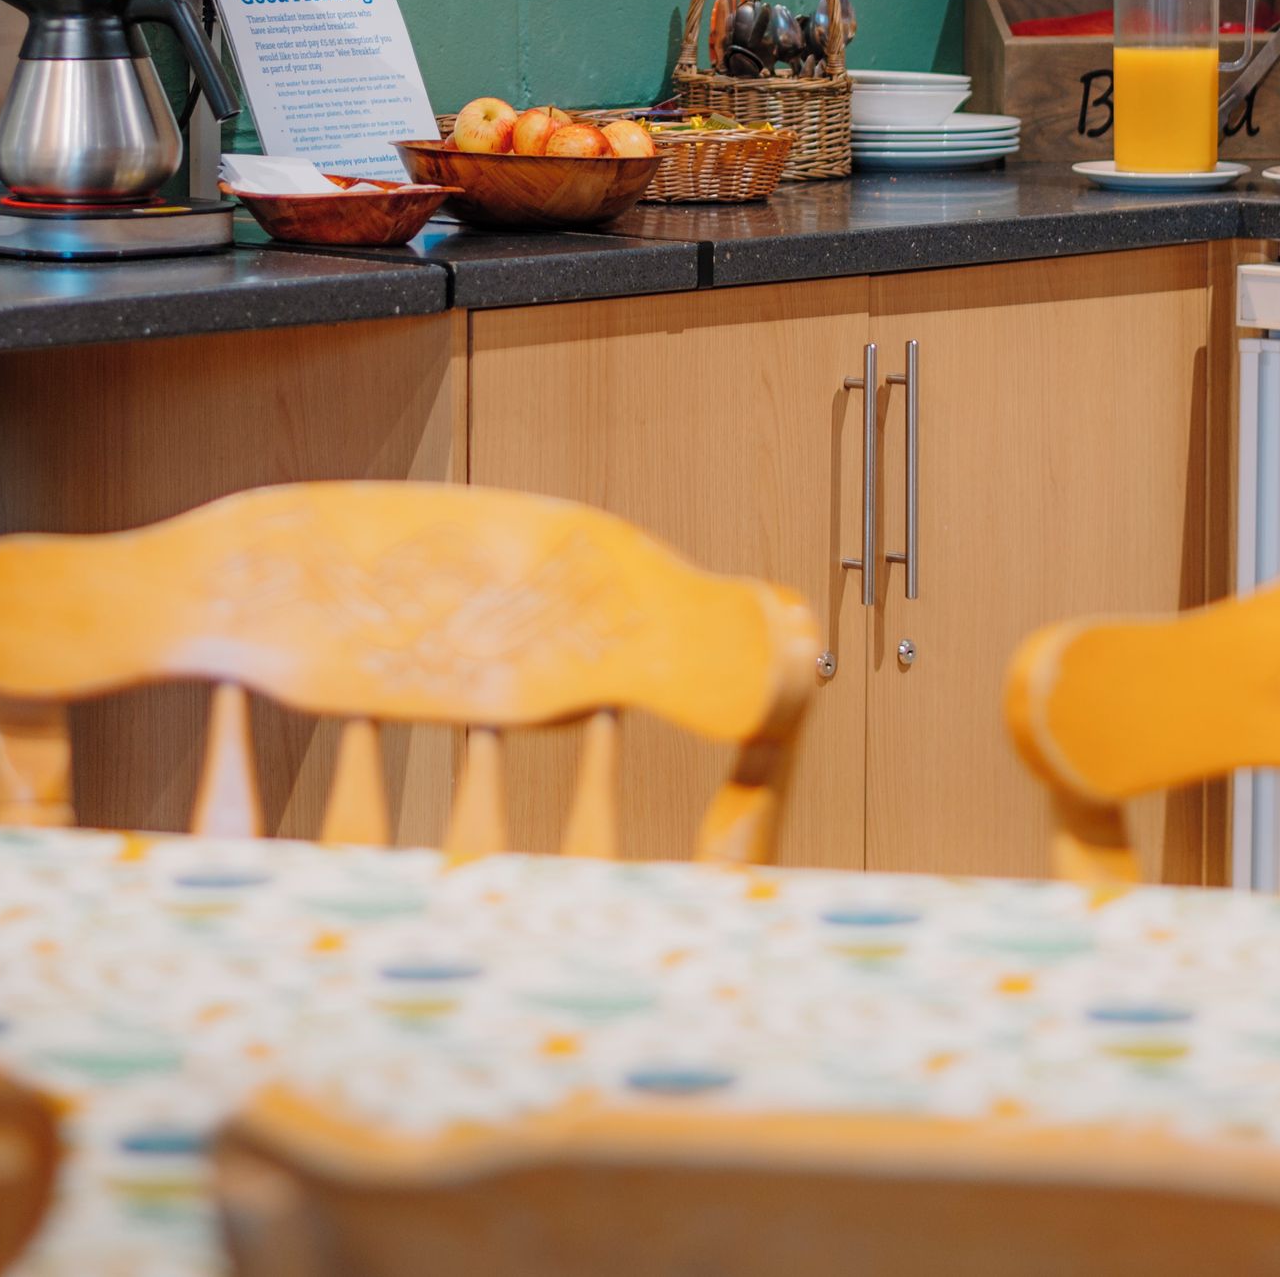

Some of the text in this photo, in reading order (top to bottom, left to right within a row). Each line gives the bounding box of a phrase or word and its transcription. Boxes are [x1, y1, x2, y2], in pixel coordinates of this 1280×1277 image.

[245, 9, 372, 24] These breakfast items are for guests who
[250, 26, 267, 35] have
[267, 24, 290, 35] already
[291, 23, 327, 34] pre-booked
[255, 41, 276, 50] Please
[276, 40, 294, 49] order
[295, 39, 308, 48] and
[308, 39, 320, 49] pay
[337, 37, 344, 45] at
[344, 35, 374, 45] reception
[380, 35, 393, 45] you
[258, 52, 279, 62] would
[280, 51, 292, 60] like
[292, 52, 299, 60] to
[300, 49, 323, 59] include
[324, 50, 335, 58] our
[262, 66, 270, 74] as
[270, 64, 284, 75] part
[284, 63, 292, 72] of
[292, 64, 308, 74] your
[335, 158, 353, 167] enjoy
[353, 157, 368, 166] your
